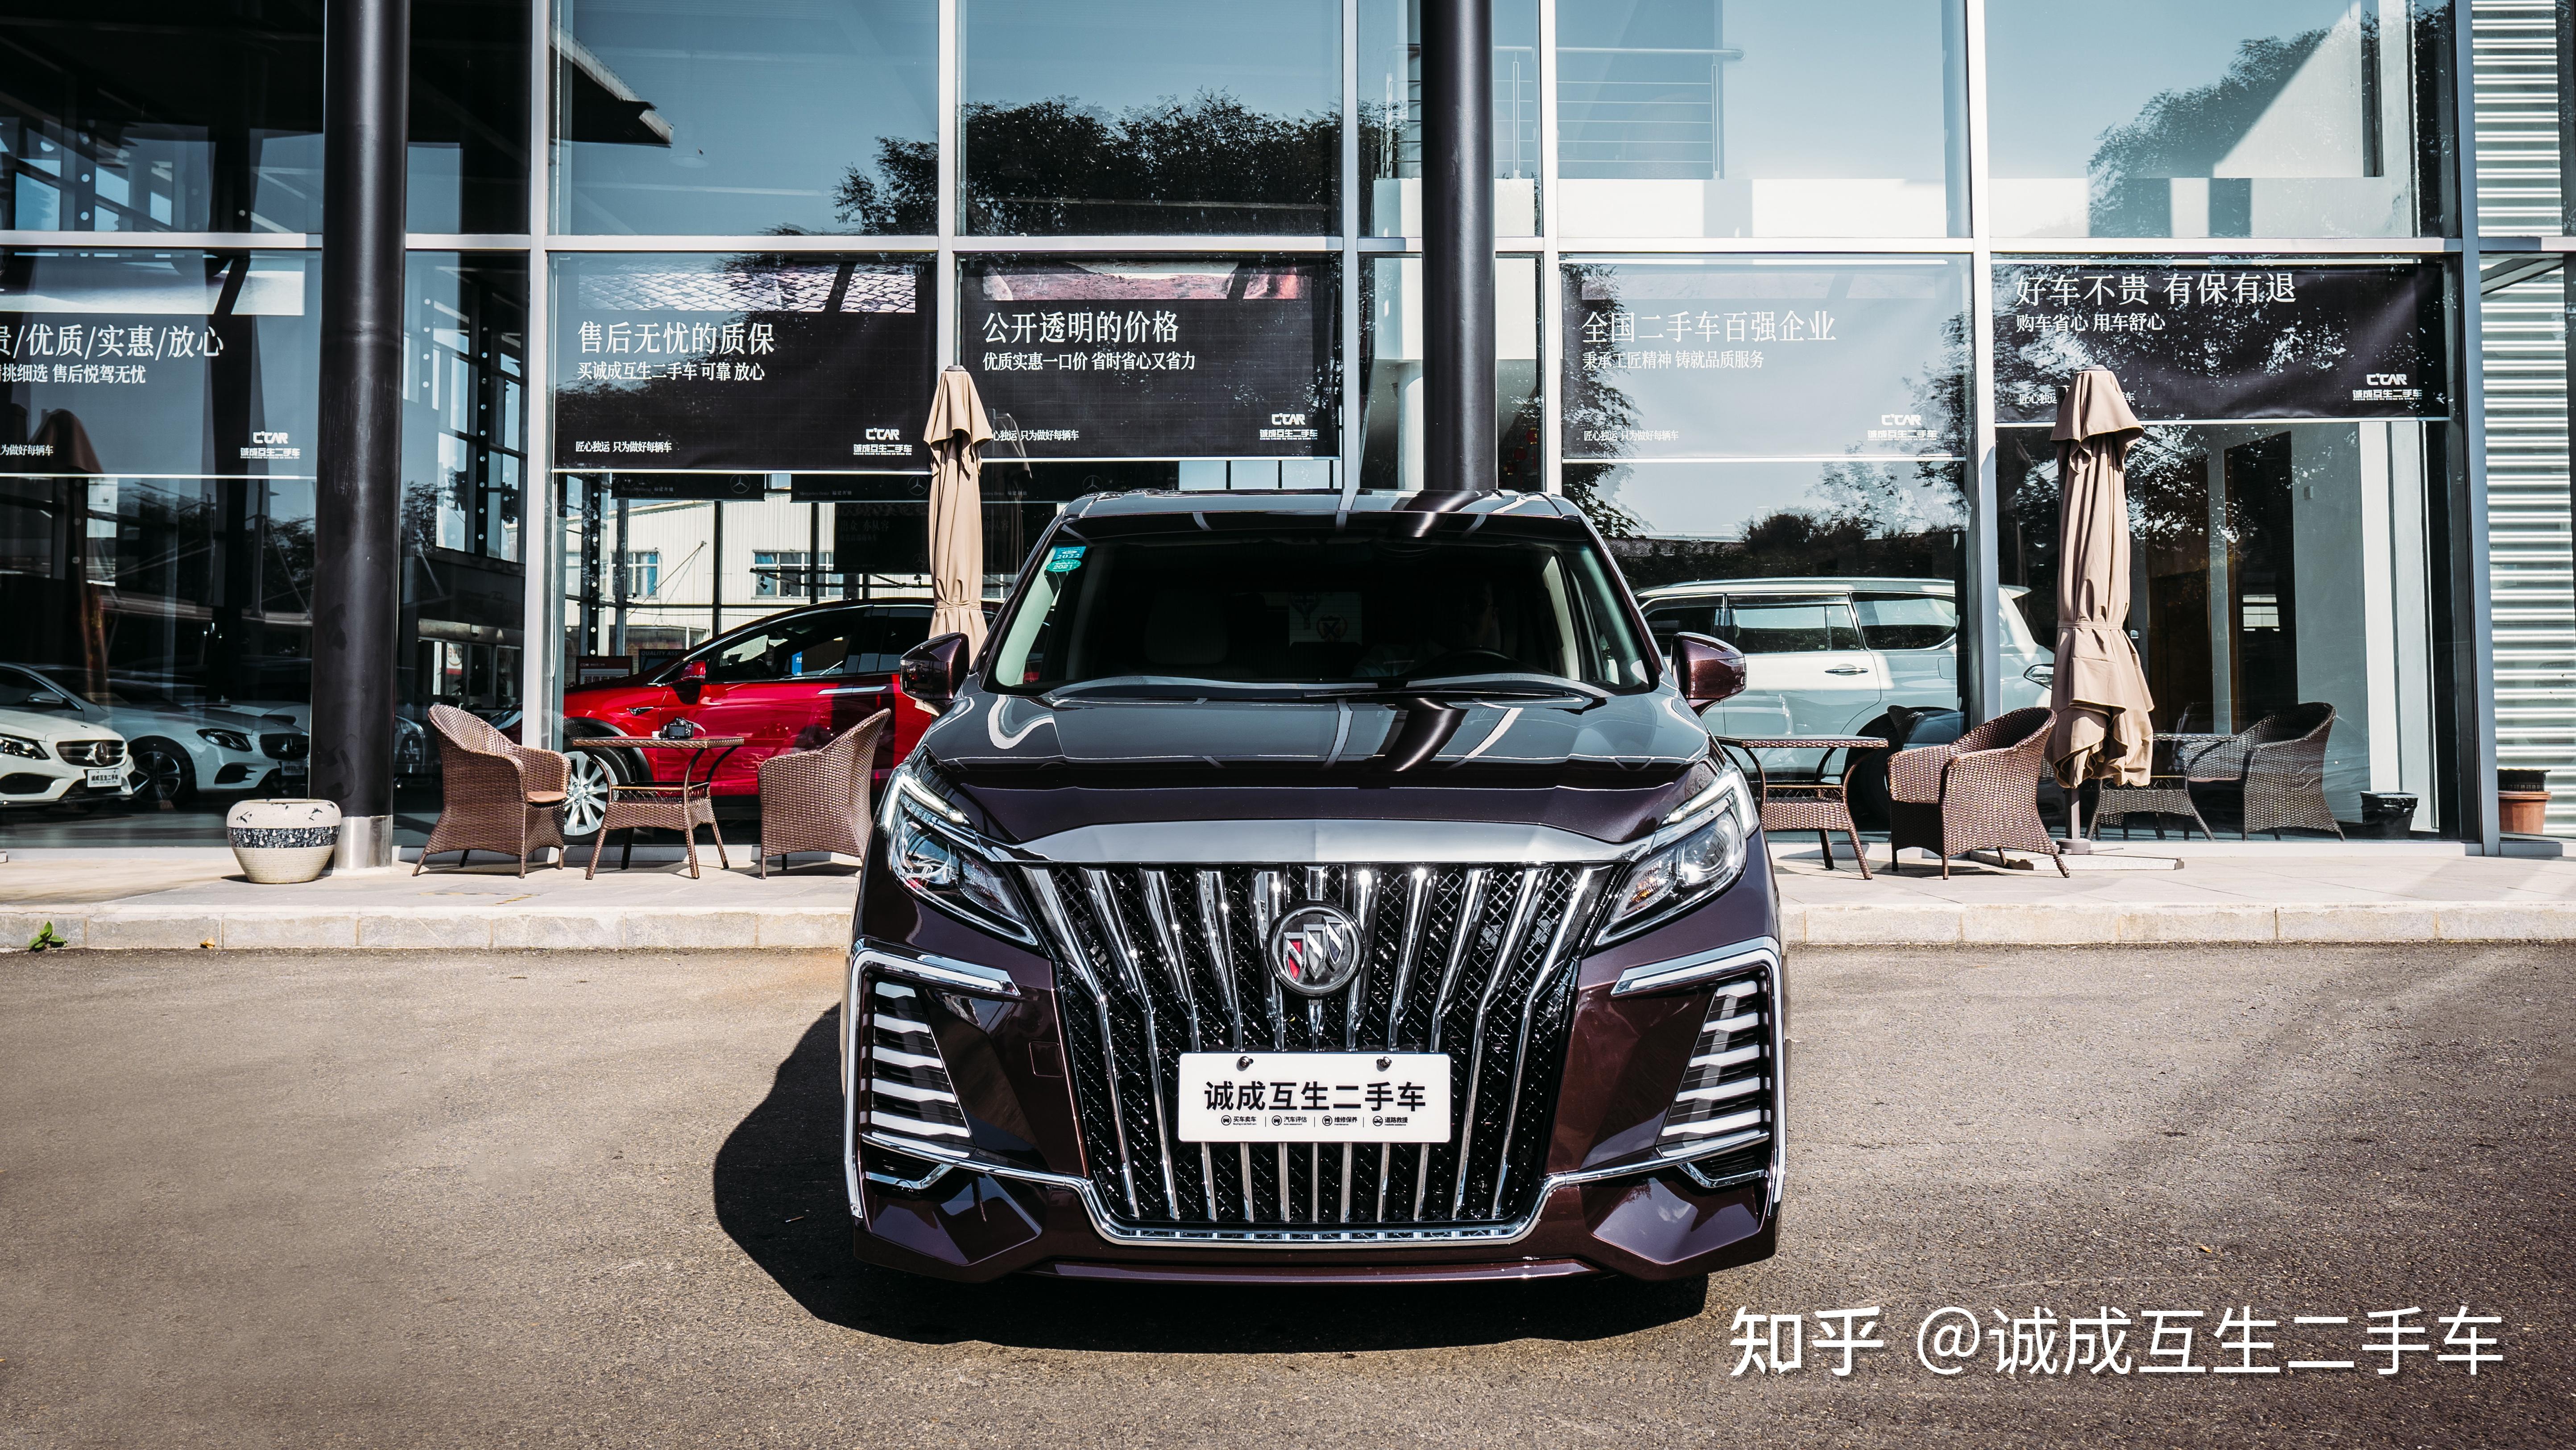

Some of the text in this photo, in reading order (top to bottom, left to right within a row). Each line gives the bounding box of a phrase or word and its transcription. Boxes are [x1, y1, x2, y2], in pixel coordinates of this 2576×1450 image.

[2015, 271, 2296, 305] 好车不贵 有保有退
[982, 310, 1179, 343] 公开透明的价格
[1582, 310, 1837, 343] 全国二手车百强企业
[2016, 312, 2166, 332] 购车省心 用车舒心
[578, 320, 775, 355] 售后无忧的质保
[982, 351, 1196, 371] 优质实惠一口价 省时省心又省力
[1582, 350, 1764, 370] 秉承工匠精神 铸就品质服务
[0, 363, 146, 384] 挑细选 售后悦驾无忧
[577, 361, 766, 382] 买诚成互生二手车 可靠 放心
[2352, 389, 2422, 398] 诚成互生二手车
[991, 429, 1079, 441] 心独运 只为做好每辆车
[1259, 429, 1318, 437] 诚成互生二手车
[1584, 430, 1679, 441] 匠心独运 只为做好每辆车
[1867, 430, 1938, 438] 诚成互生二手车
[0, 444, 54, 456] 为做好每辆车
[240, 448, 300, 456] 诚成互生二手车
[576, 441, 672, 453] 匠心独运 只为做好每辆车
[853, 444, 912, 453] 诚成互生二手车
[1205, 1080, 1426, 1112] 诚成互生二手车
